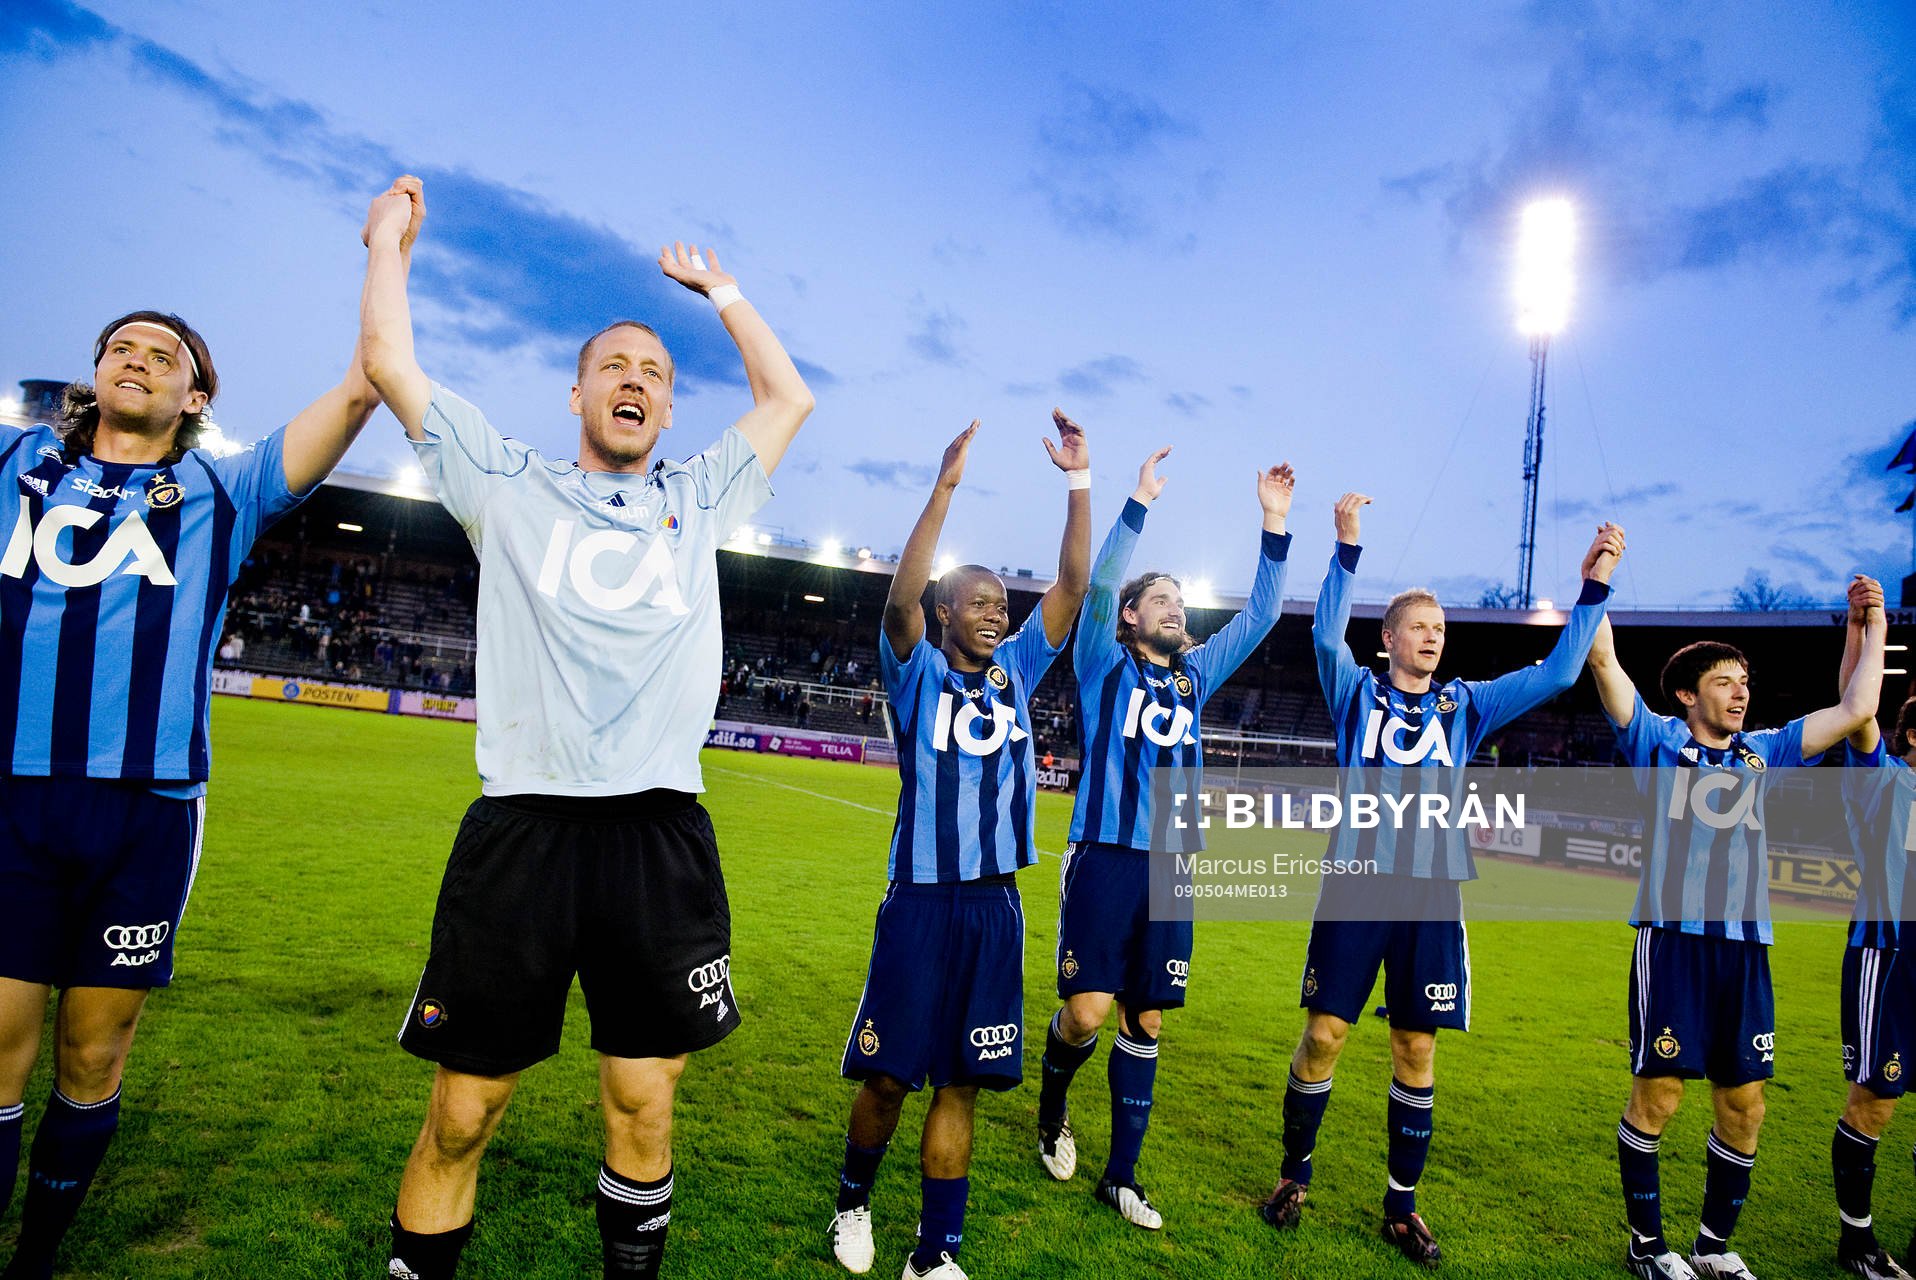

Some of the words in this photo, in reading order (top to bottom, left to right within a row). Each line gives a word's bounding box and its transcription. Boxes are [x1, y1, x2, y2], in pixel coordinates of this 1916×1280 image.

[0, 494, 179, 587] ICA
[537, 519, 691, 616] ICA
[933, 692, 1030, 756] ICA
[1122, 687, 1198, 747] ICA
[1361, 709, 1455, 767] ICA
[821, 743, 853, 757] TELIA
[1036, 767, 1069, 787] tadium
[1668, 766, 1762, 831] ICA
[1499, 828, 1524, 847] LG
[110, 950, 160, 966] Audi
[978, 1046, 1013, 1061] Audi
[1122, 1097, 1151, 1107] DIF
[1401, 1125, 1431, 1139] DIF
[1633, 1190, 1657, 1200] DIF
[945, 1234, 963, 1243] DI
